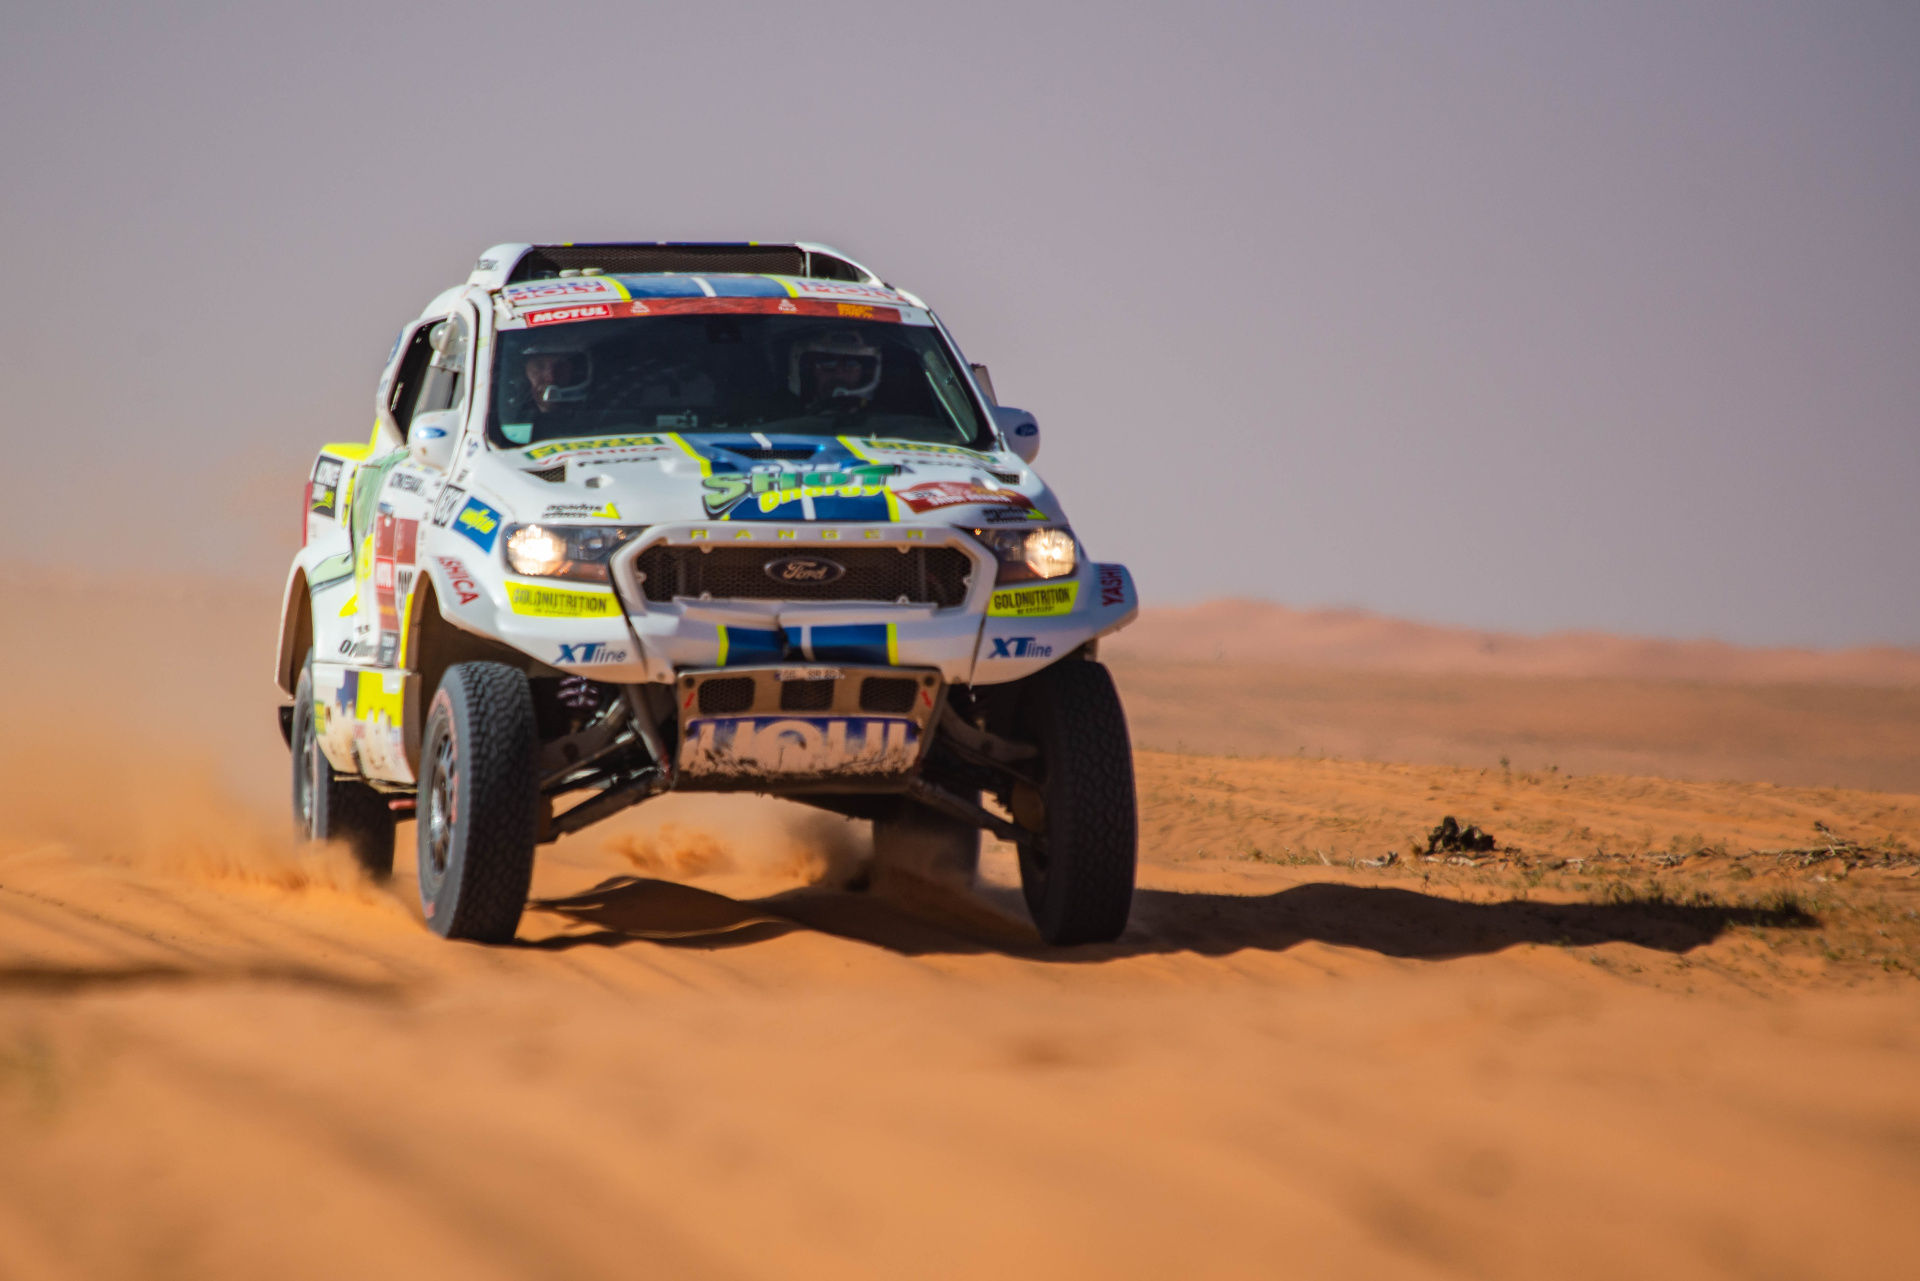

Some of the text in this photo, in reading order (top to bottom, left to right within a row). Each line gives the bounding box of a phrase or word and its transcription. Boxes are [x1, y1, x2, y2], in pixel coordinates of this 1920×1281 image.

[532, 306, 607, 323] MOTUL
[702, 464, 904, 516] SHOT
[690, 529, 925, 540] RANGER
[782, 560, 829, 581] Ford
[513, 587, 608, 613] GOLDNUTRITION
[993, 587, 1071, 611] GOLDNUTRITION
